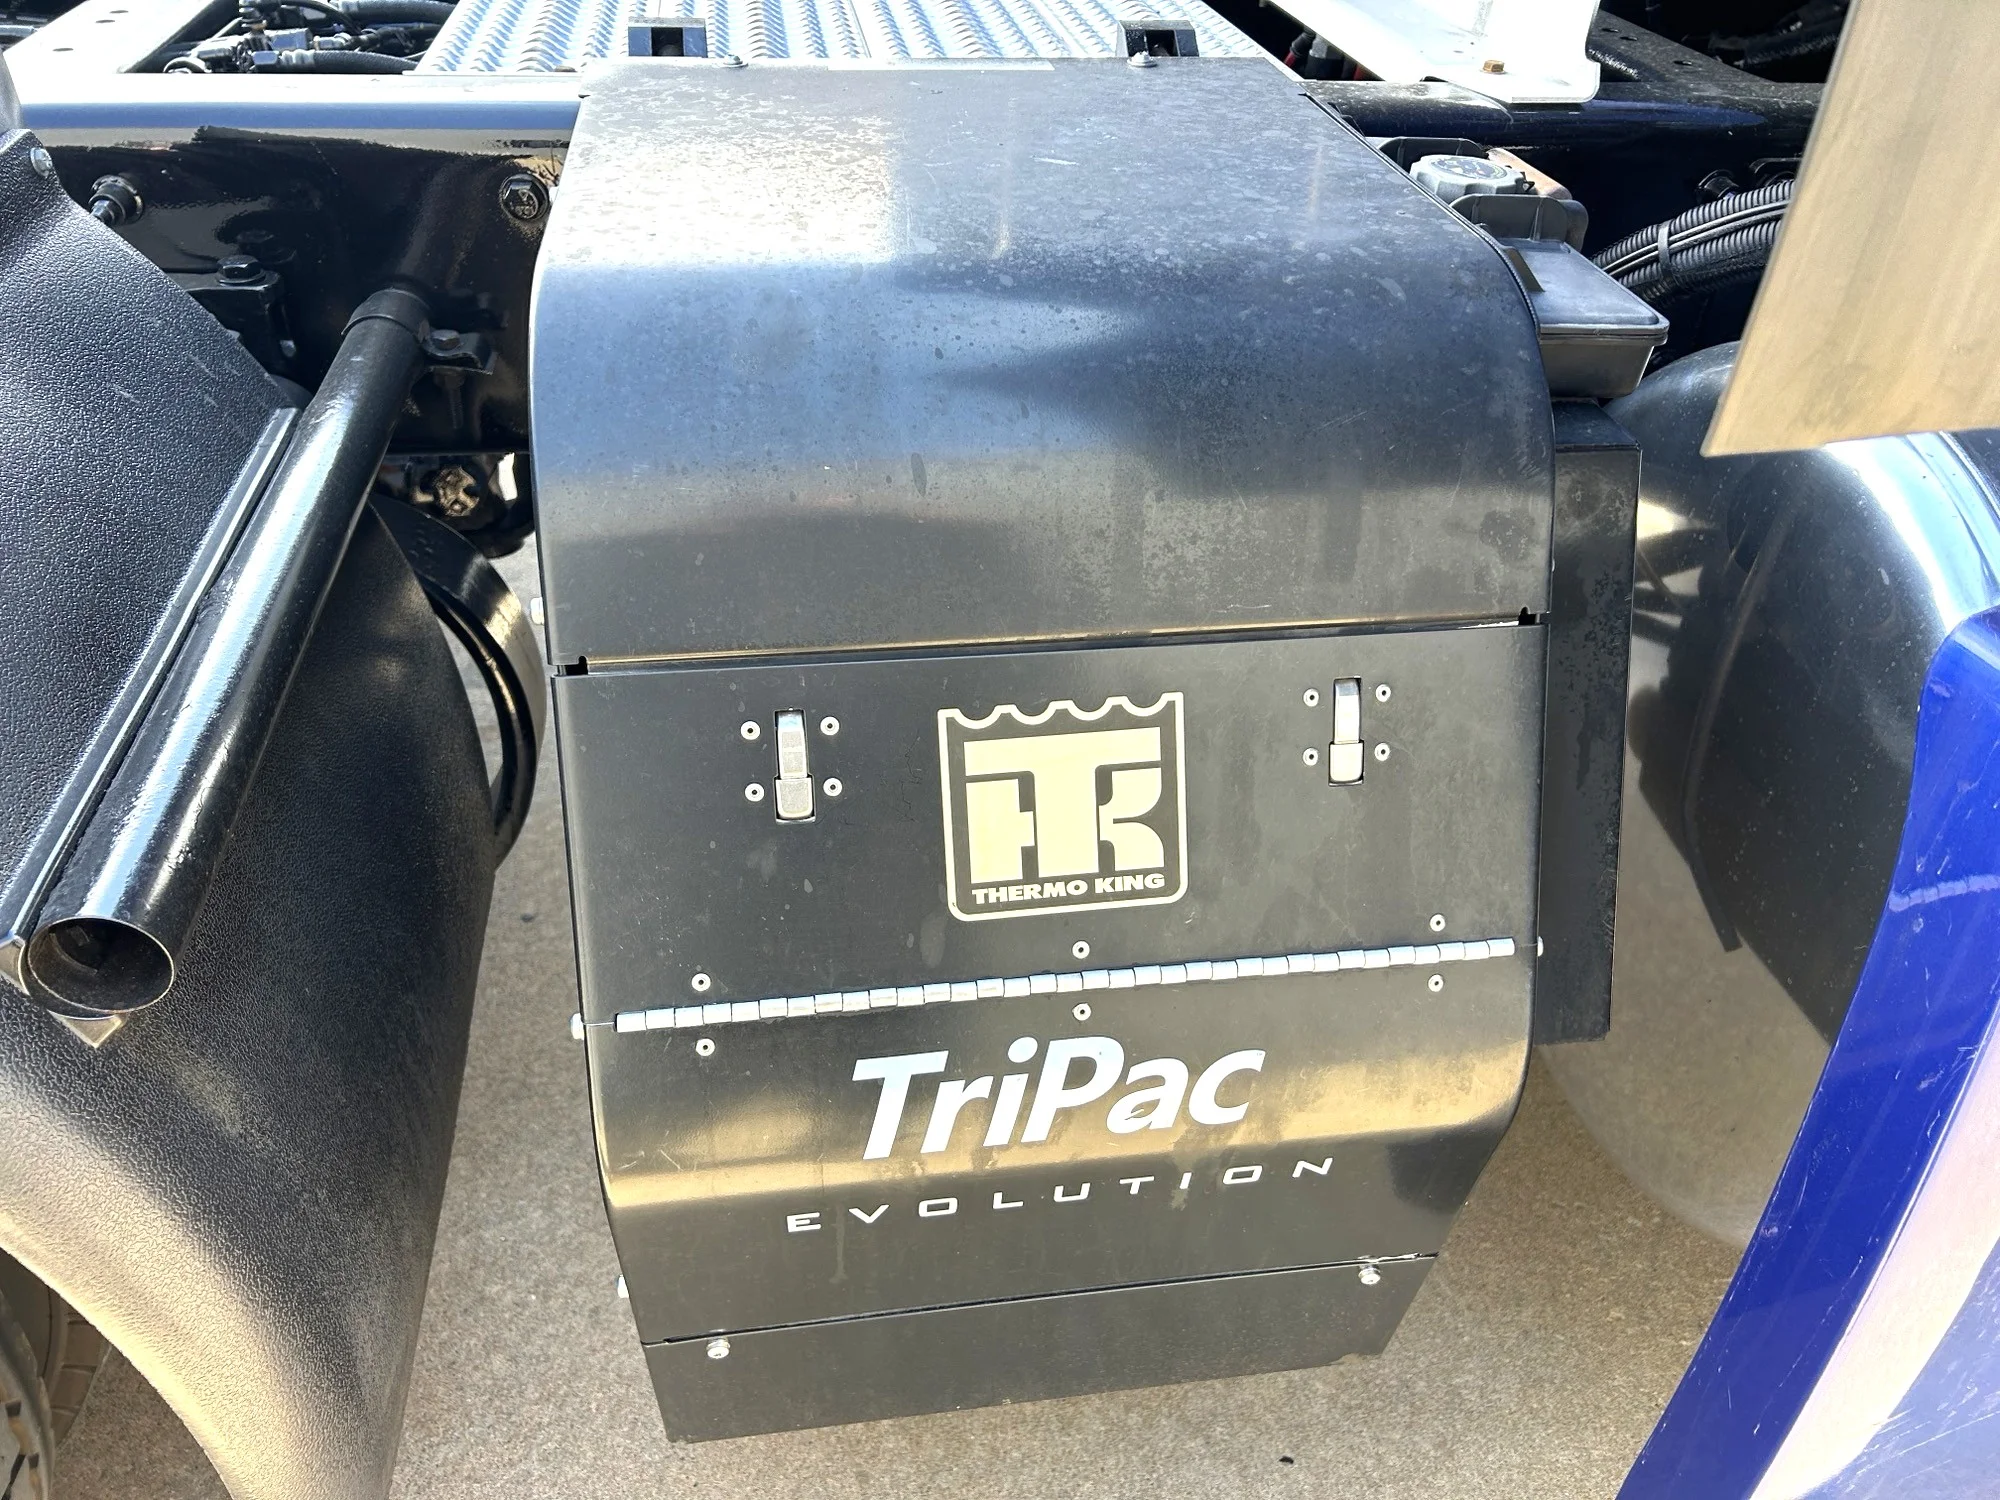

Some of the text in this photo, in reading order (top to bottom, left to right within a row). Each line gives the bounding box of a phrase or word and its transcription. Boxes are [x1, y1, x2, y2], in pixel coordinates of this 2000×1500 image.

[971, 873, 1166, 905] THERMO KING
[852, 1036, 1267, 1160] TriPac
[786, 1157, 1334, 1233] EVOLUTION
